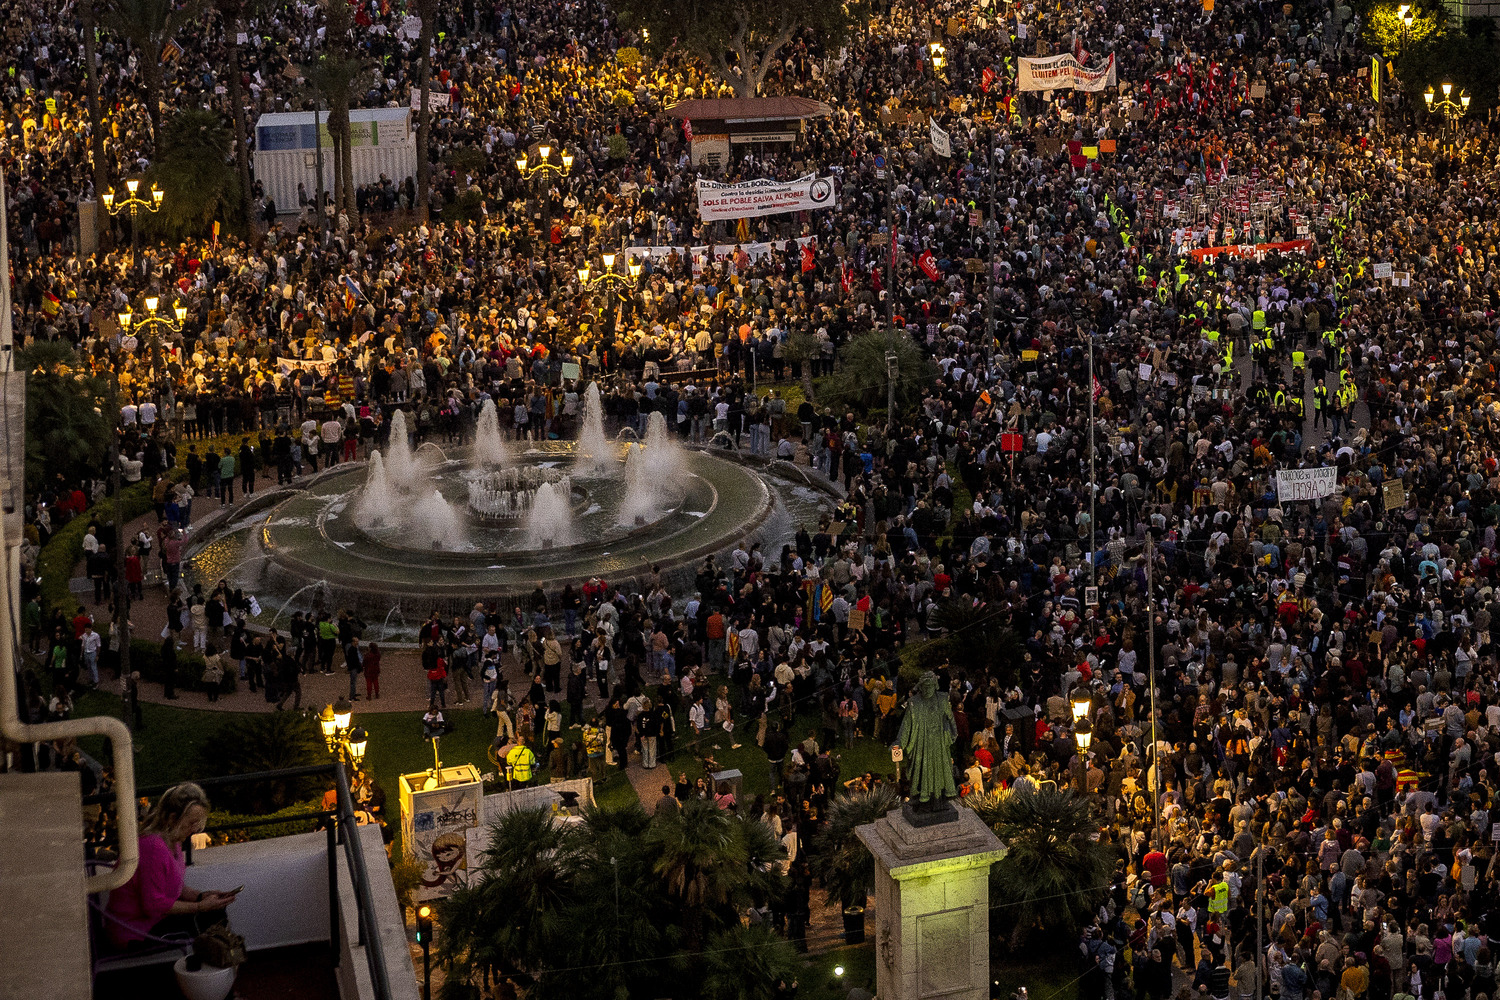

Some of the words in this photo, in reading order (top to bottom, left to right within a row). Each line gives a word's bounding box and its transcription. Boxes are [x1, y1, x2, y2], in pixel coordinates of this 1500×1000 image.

[1032, 69, 1058, 78] LLUITEM
[1060, 68, 1070, 76] PEL
[753, 195, 773, 204] SALVA
